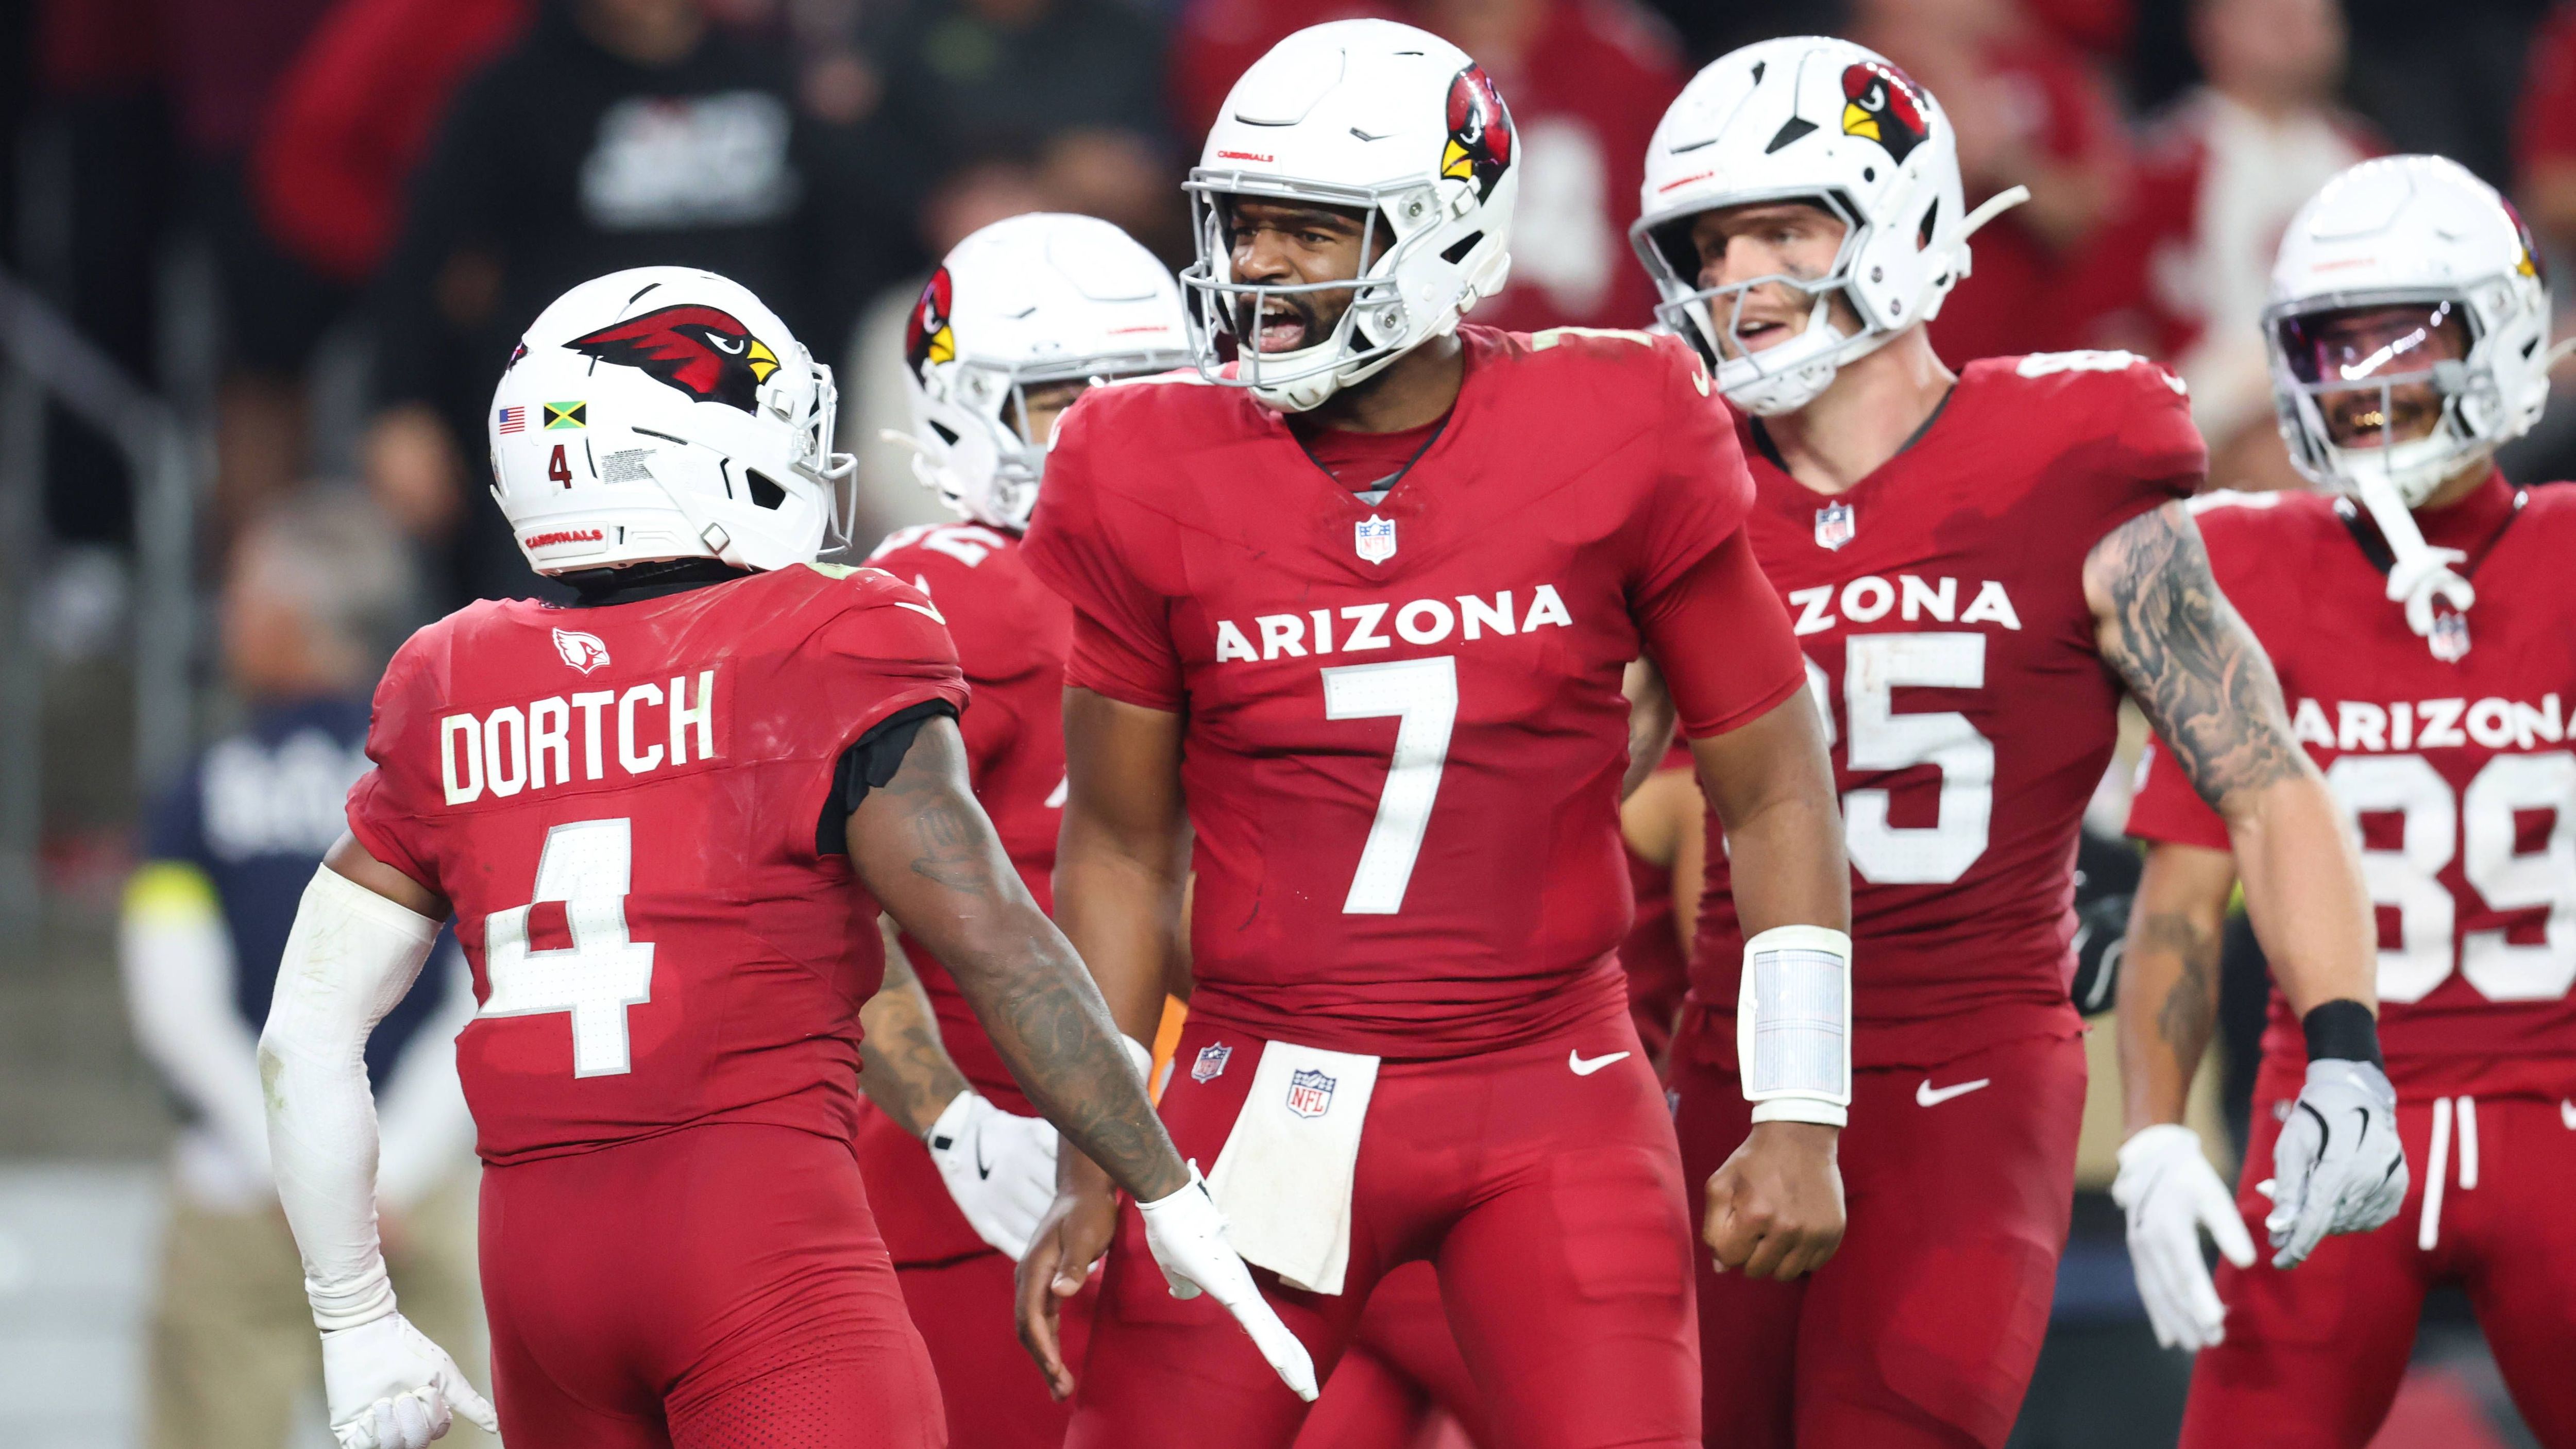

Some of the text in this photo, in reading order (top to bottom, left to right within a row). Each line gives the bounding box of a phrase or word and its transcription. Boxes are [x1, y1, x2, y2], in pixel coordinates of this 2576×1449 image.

[549, 445, 571, 488] 4
[525, 529, 603, 550] CARDINALS
[1363, 536, 1388, 553] NFL
[1216, 584, 1573, 663] ARIZONA
[1789, 575, 2022, 636] ZONA
[440, 669, 716, 806] DORTCH
[2294, 692, 2576, 751] ARIZON
[1320, 655, 1459, 915] 7
[1803, 631, 1995, 884] 5
[2325, 751, 2576, 1004] 89
[476, 817, 655, 1079] 4
[1291, 1087, 1324, 1112] NFL
